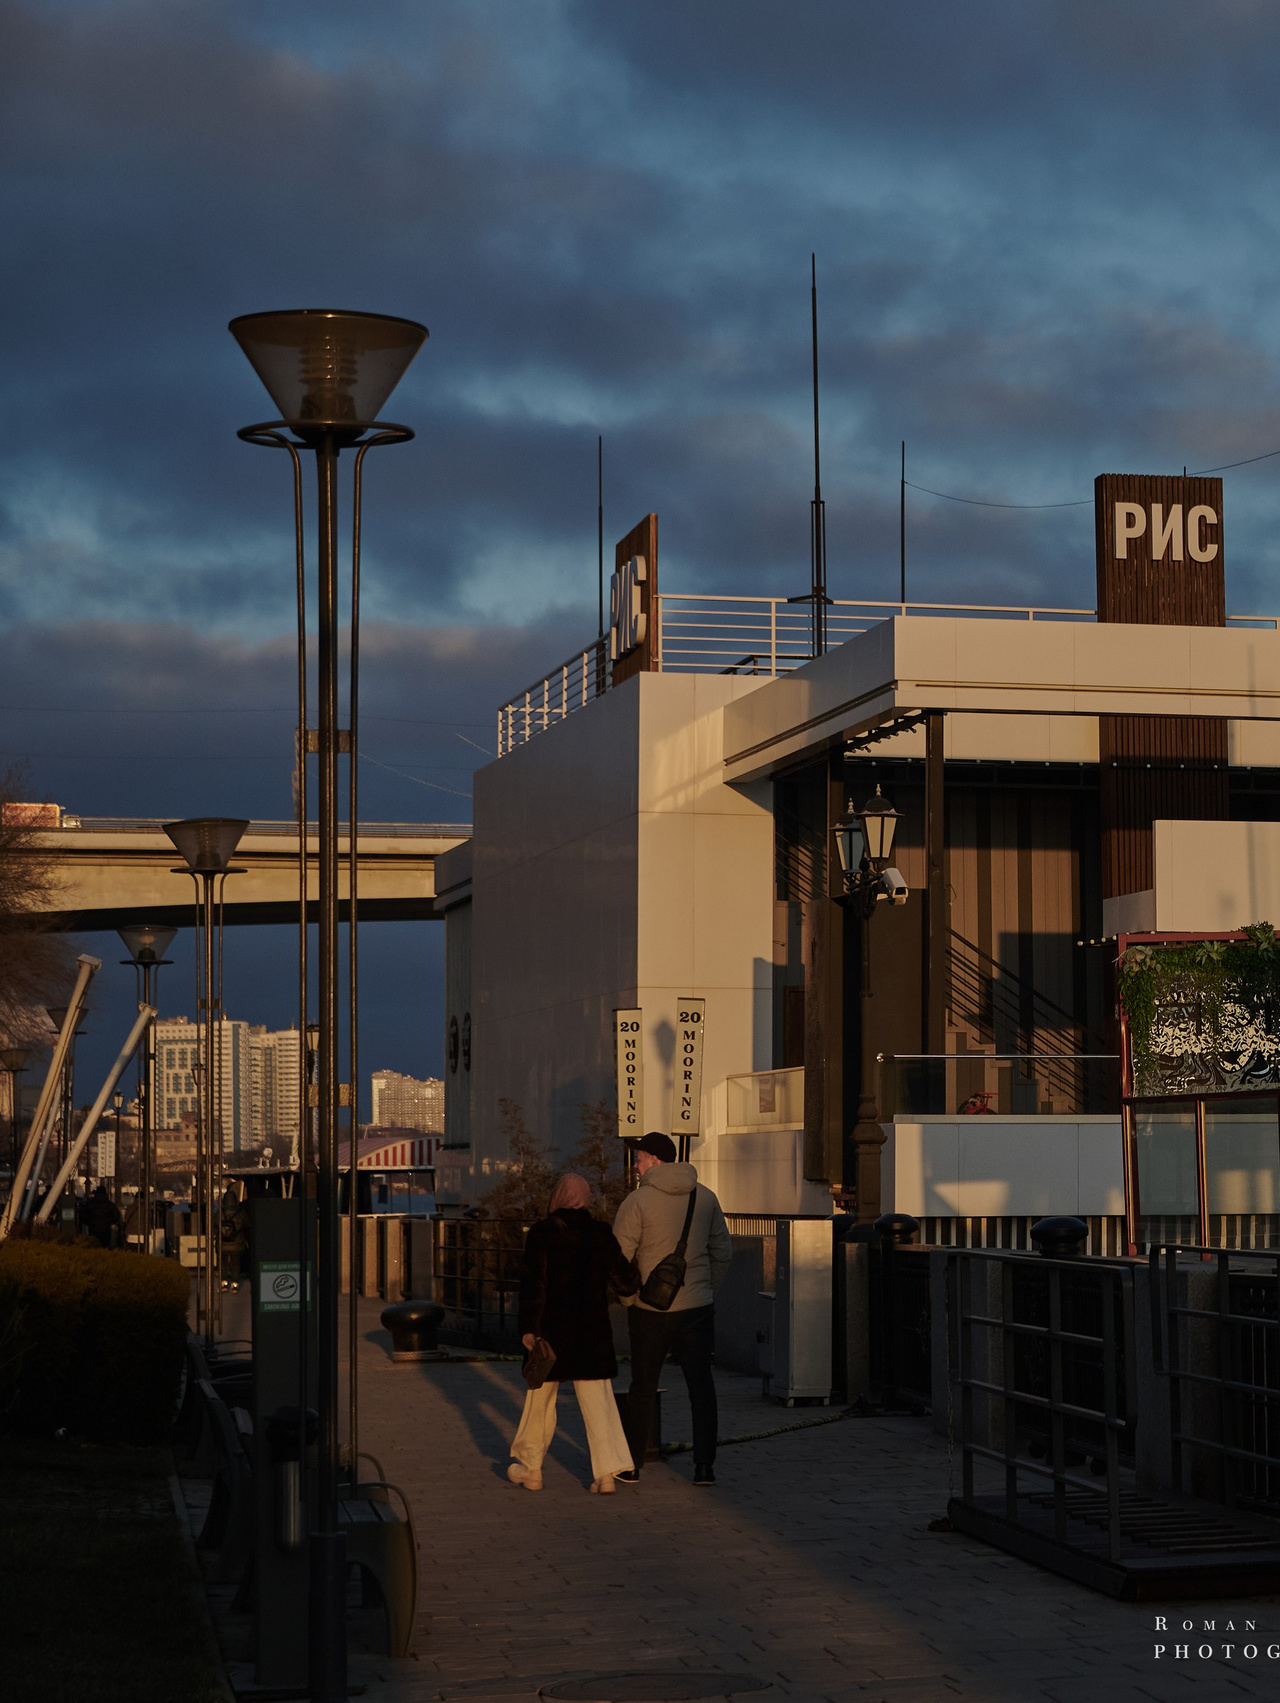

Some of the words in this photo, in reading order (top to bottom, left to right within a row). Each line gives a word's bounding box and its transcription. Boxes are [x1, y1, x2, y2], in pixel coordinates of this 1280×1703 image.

[1113, 501, 1219, 563] РИС
[610, 554, 647, 661] РИС
[620, 1021, 640, 1033] 20
[679, 1011, 701, 1023] 20
[624, 1039, 637, 1124] MOORING
[680, 1030, 696, 1121] MOORING
